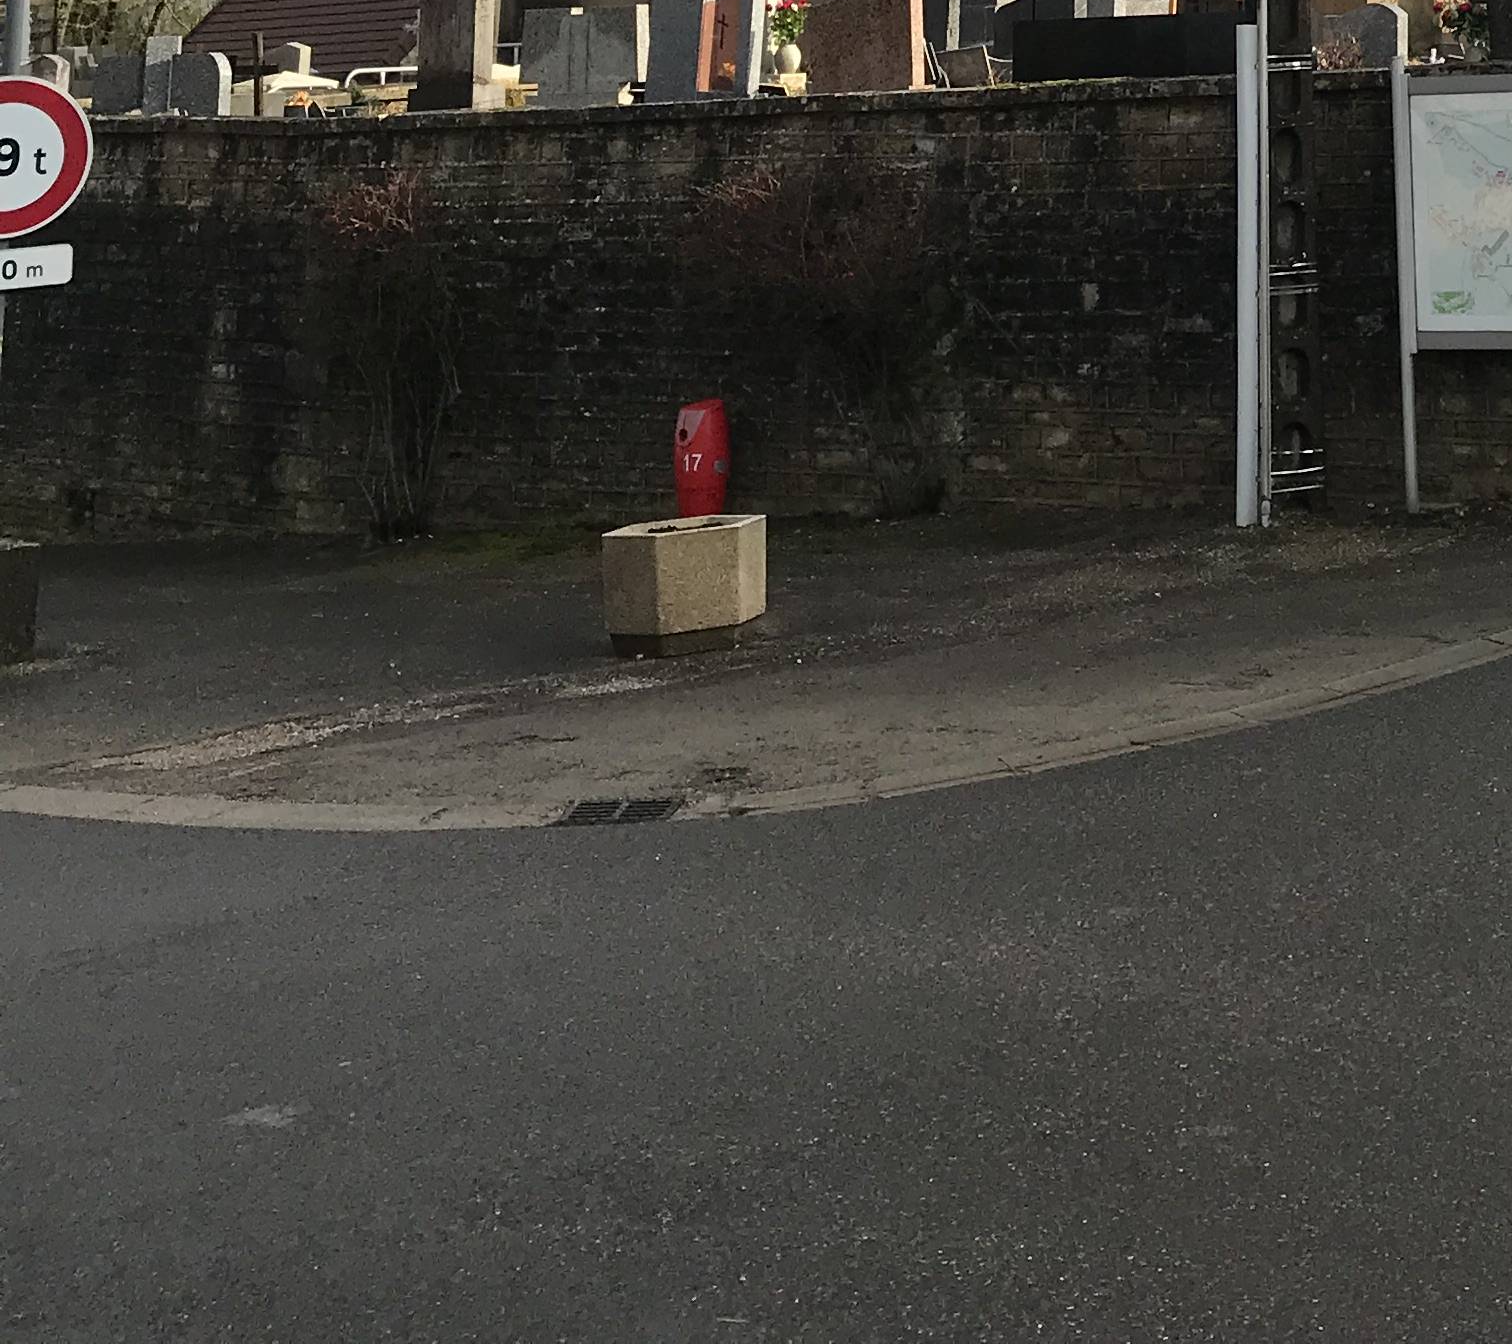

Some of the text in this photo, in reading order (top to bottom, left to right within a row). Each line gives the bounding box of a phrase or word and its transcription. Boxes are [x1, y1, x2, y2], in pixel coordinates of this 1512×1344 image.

[34, 148, 47, 175] t
[26, 264, 43, 278] m
[683, 453, 702, 472] 17
